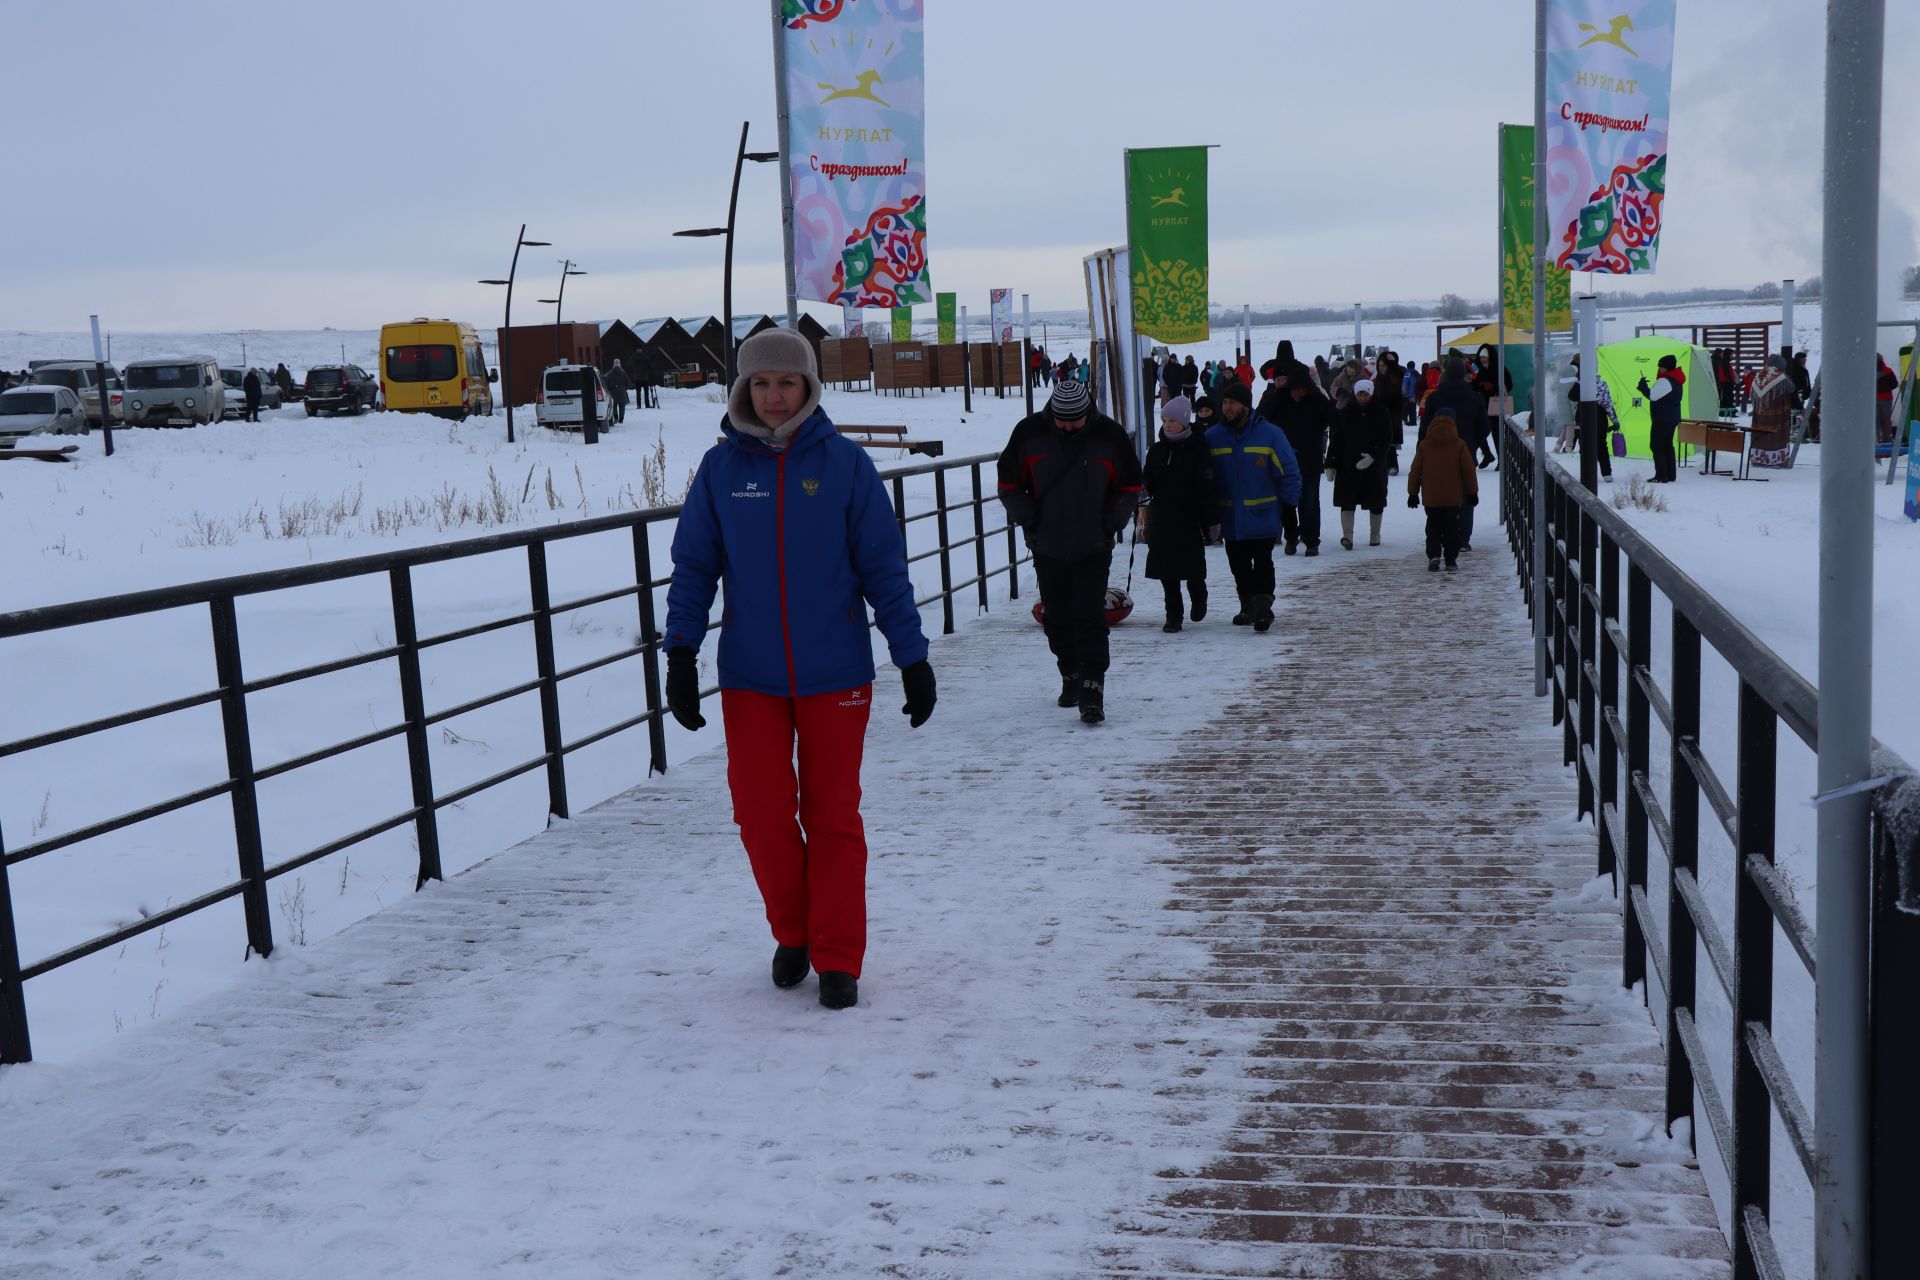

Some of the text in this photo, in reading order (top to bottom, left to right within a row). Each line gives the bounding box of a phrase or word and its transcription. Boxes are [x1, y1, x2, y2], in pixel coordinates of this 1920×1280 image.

[1576, 72, 1637, 94] НУРЛАТ
[1561, 102, 1649, 133] С праздником!
[819, 126, 893, 142] НУРЛАТ
[810, 154, 907, 181] С праздником!
[1151, 216, 1189, 226] НУРЛАТ
